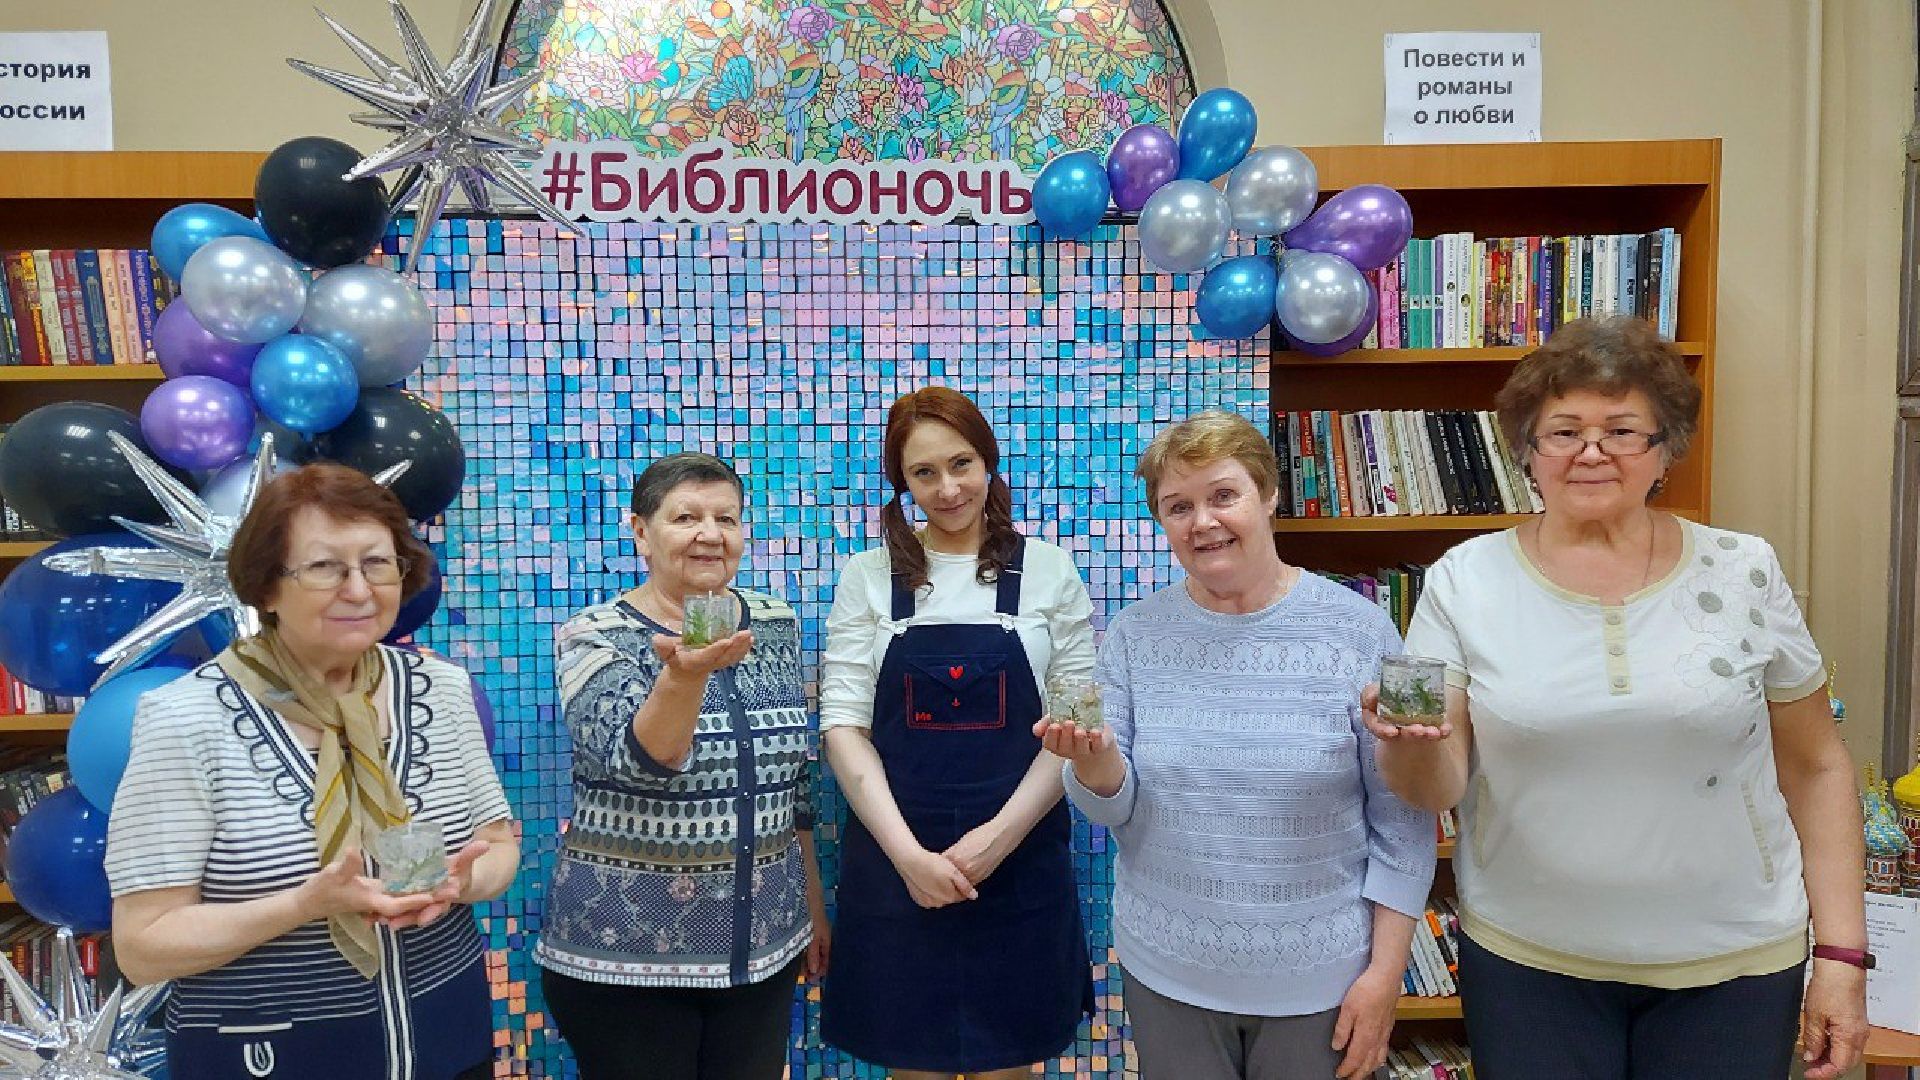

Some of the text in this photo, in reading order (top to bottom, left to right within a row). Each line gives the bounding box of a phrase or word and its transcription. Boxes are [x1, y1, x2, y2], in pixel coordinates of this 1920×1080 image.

[1404, 48, 1525, 68] Повести и
[1418, 80, 1513, 101] романы
[0, 104, 85, 121] оссии
[1413, 104, 1514, 125] о любви
[541, 147, 1032, 215] #Библионочь
